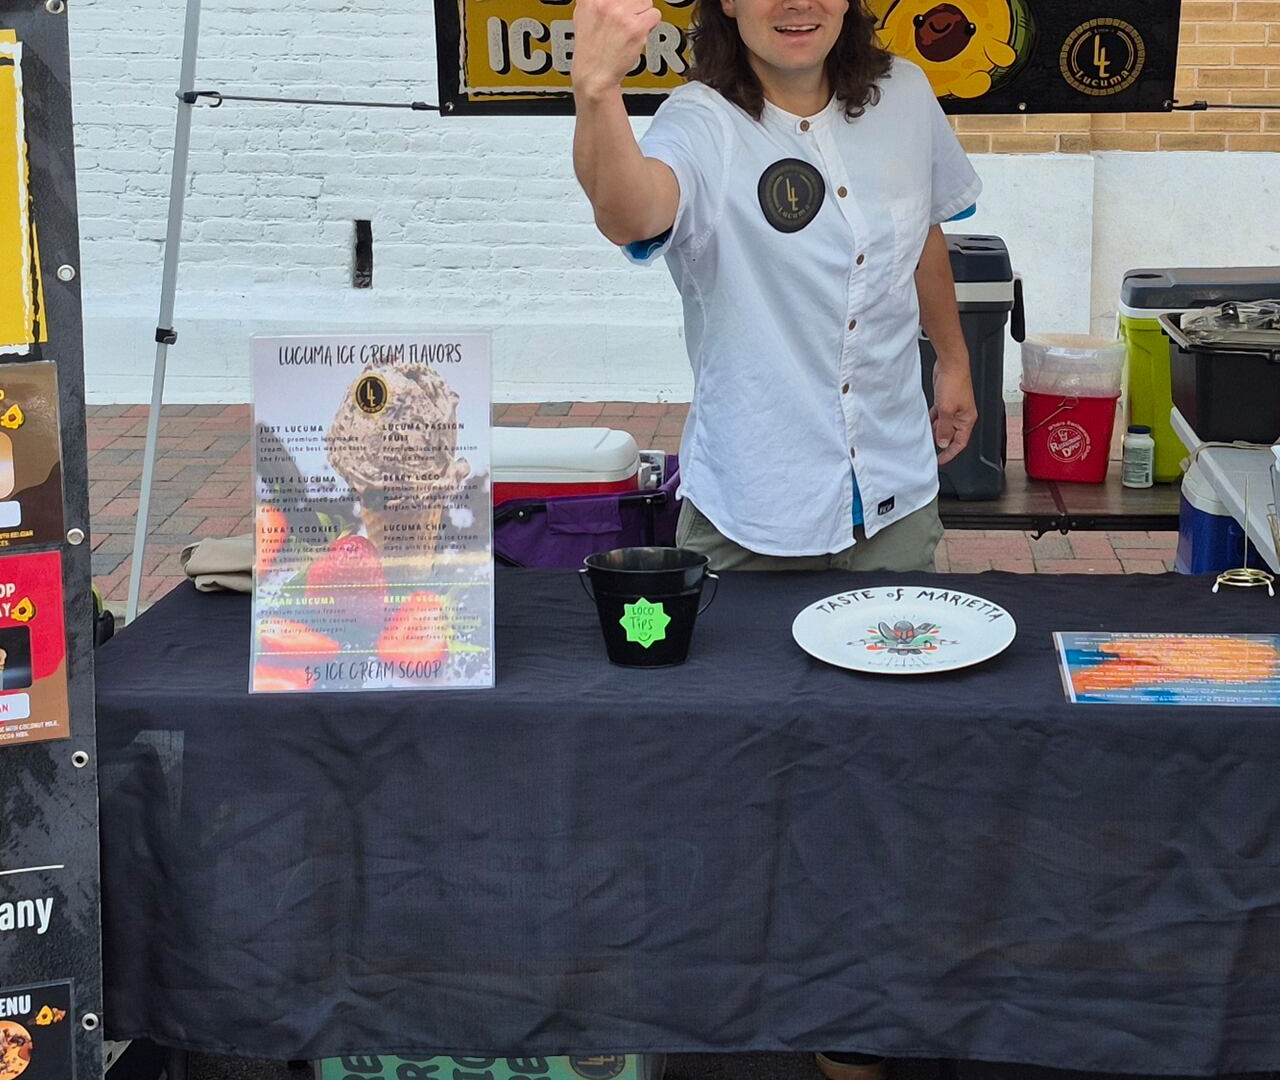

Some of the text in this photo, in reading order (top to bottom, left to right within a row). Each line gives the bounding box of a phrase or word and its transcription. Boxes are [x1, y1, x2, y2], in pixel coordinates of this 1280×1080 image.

[1074, 70, 1129, 87] Lucuma
[278, 343, 462, 366] LUCUMA ICE CREAM FLAVORS
[631, 605, 655, 617] LOCO
[815, 588, 1004, 622] TASTE of MARIETTA
[304, 661, 442, 684] $5 ICE CREAM SCOOP
